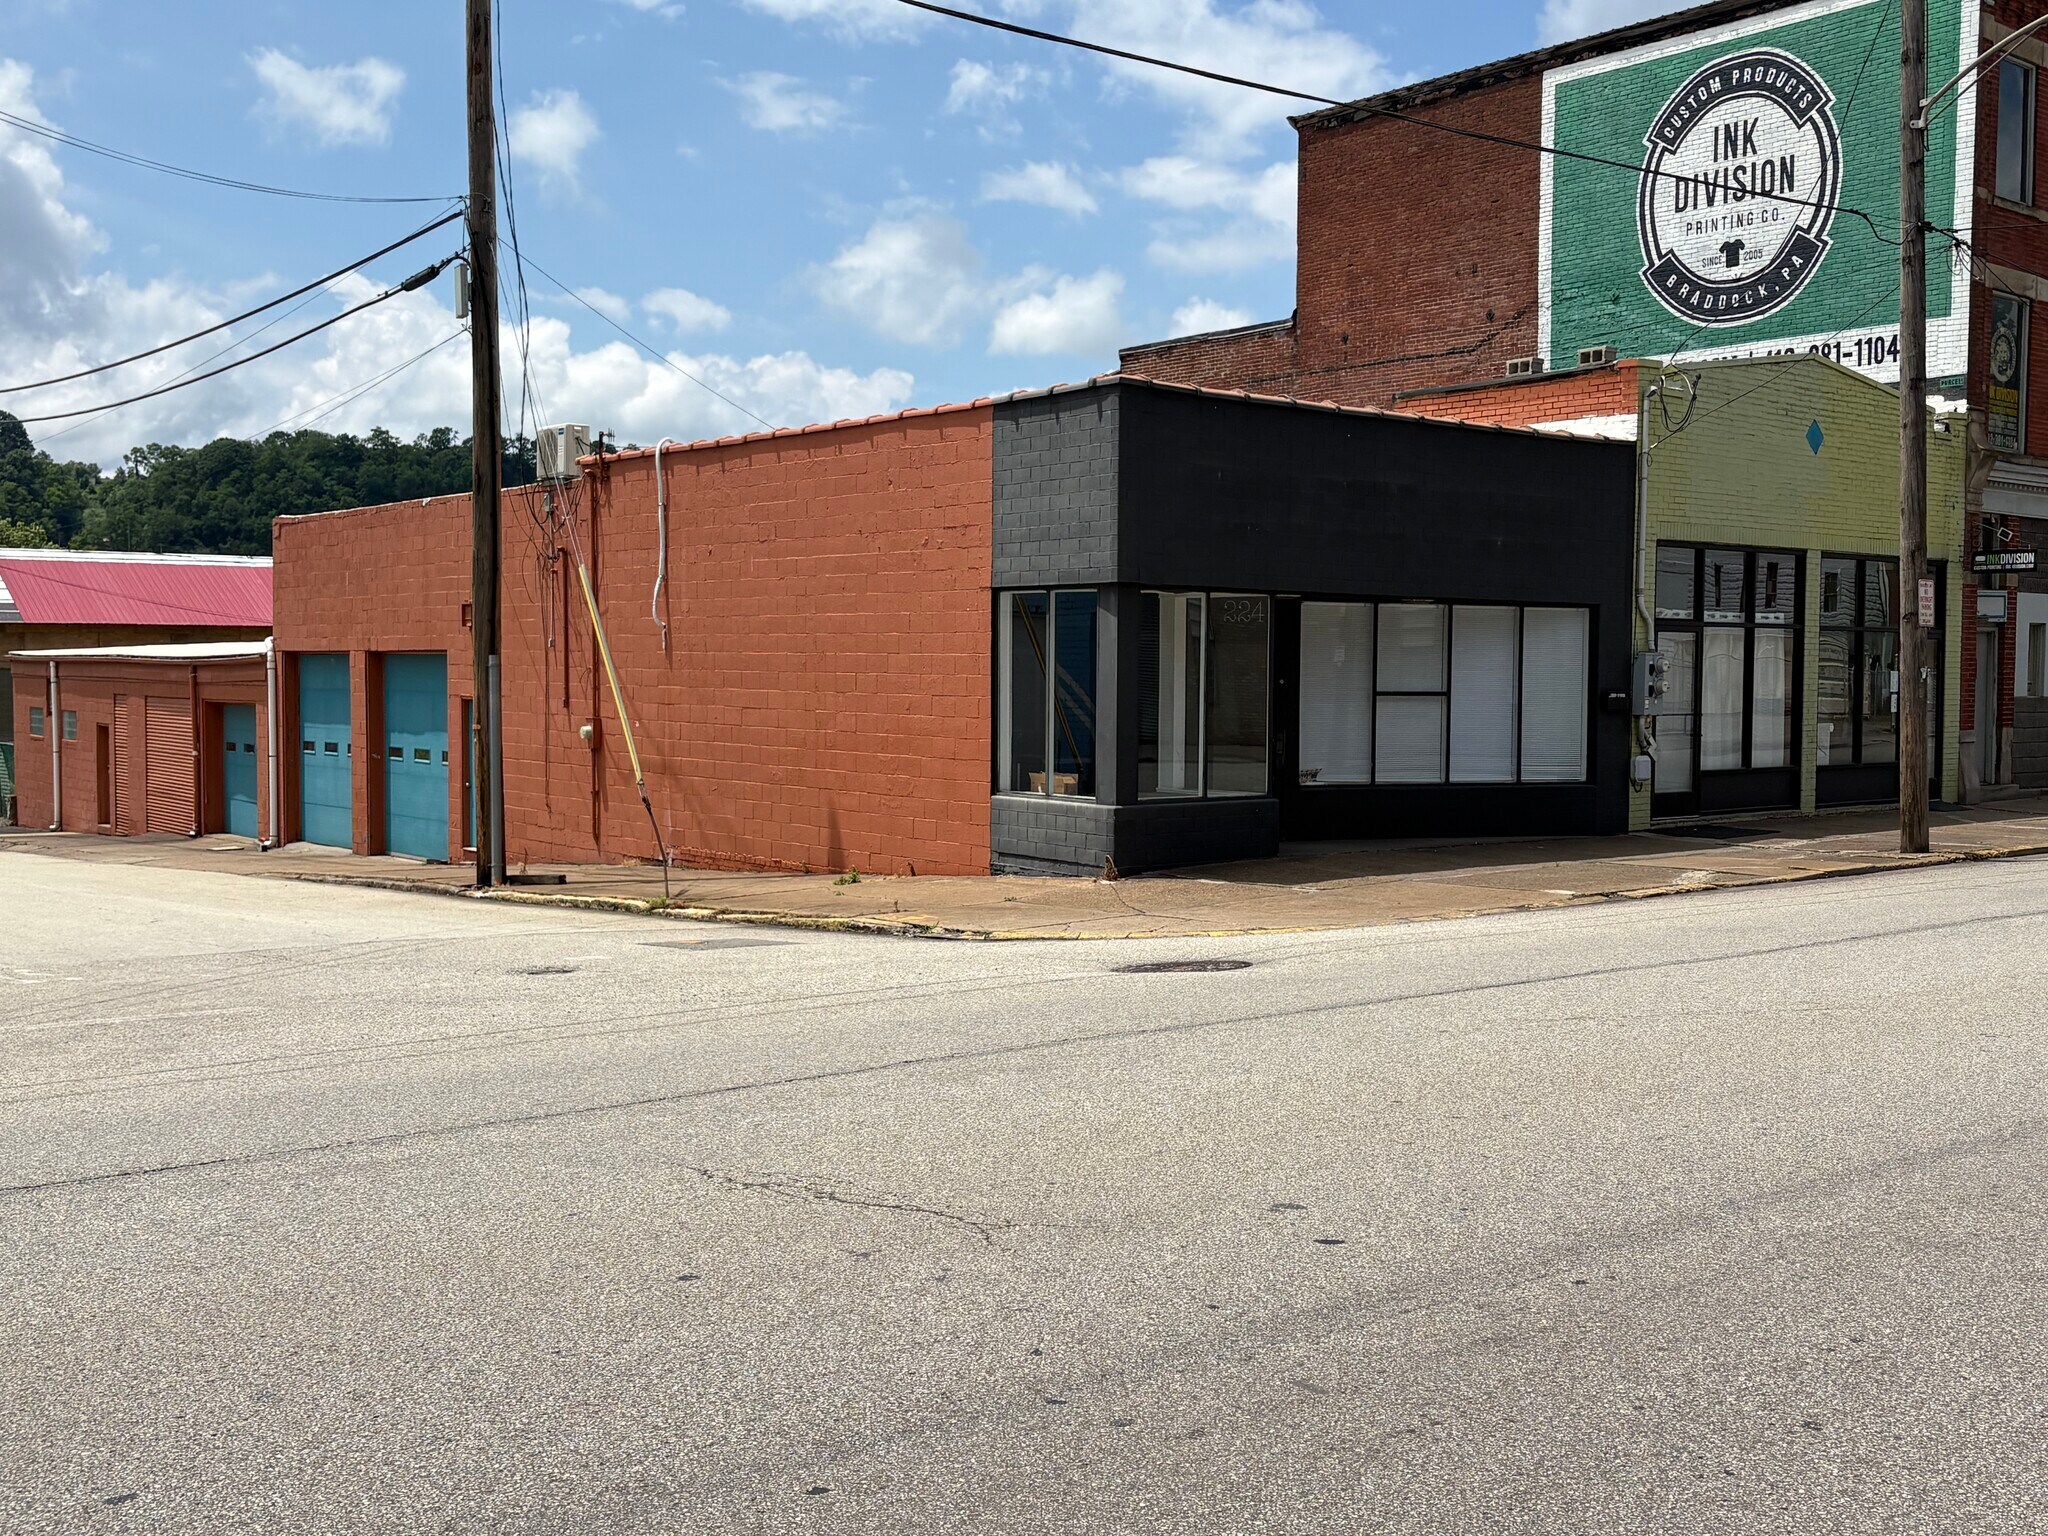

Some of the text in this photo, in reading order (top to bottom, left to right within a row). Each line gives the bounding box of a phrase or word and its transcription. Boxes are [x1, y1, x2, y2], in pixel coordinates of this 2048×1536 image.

[1664, 67, 1812, 139] CUSTOM PRODUCTS
[1713, 117, 1759, 162] INK
[1675, 154, 1795, 213] DIVISION
[1686, 207, 1786, 236] PRINTING CO.
[1701, 249, 1763, 268] SINCE 2005
[1665, 256, 1804, 310] BRADDOCK, PA
[1223, 600, 1266, 624] 224
